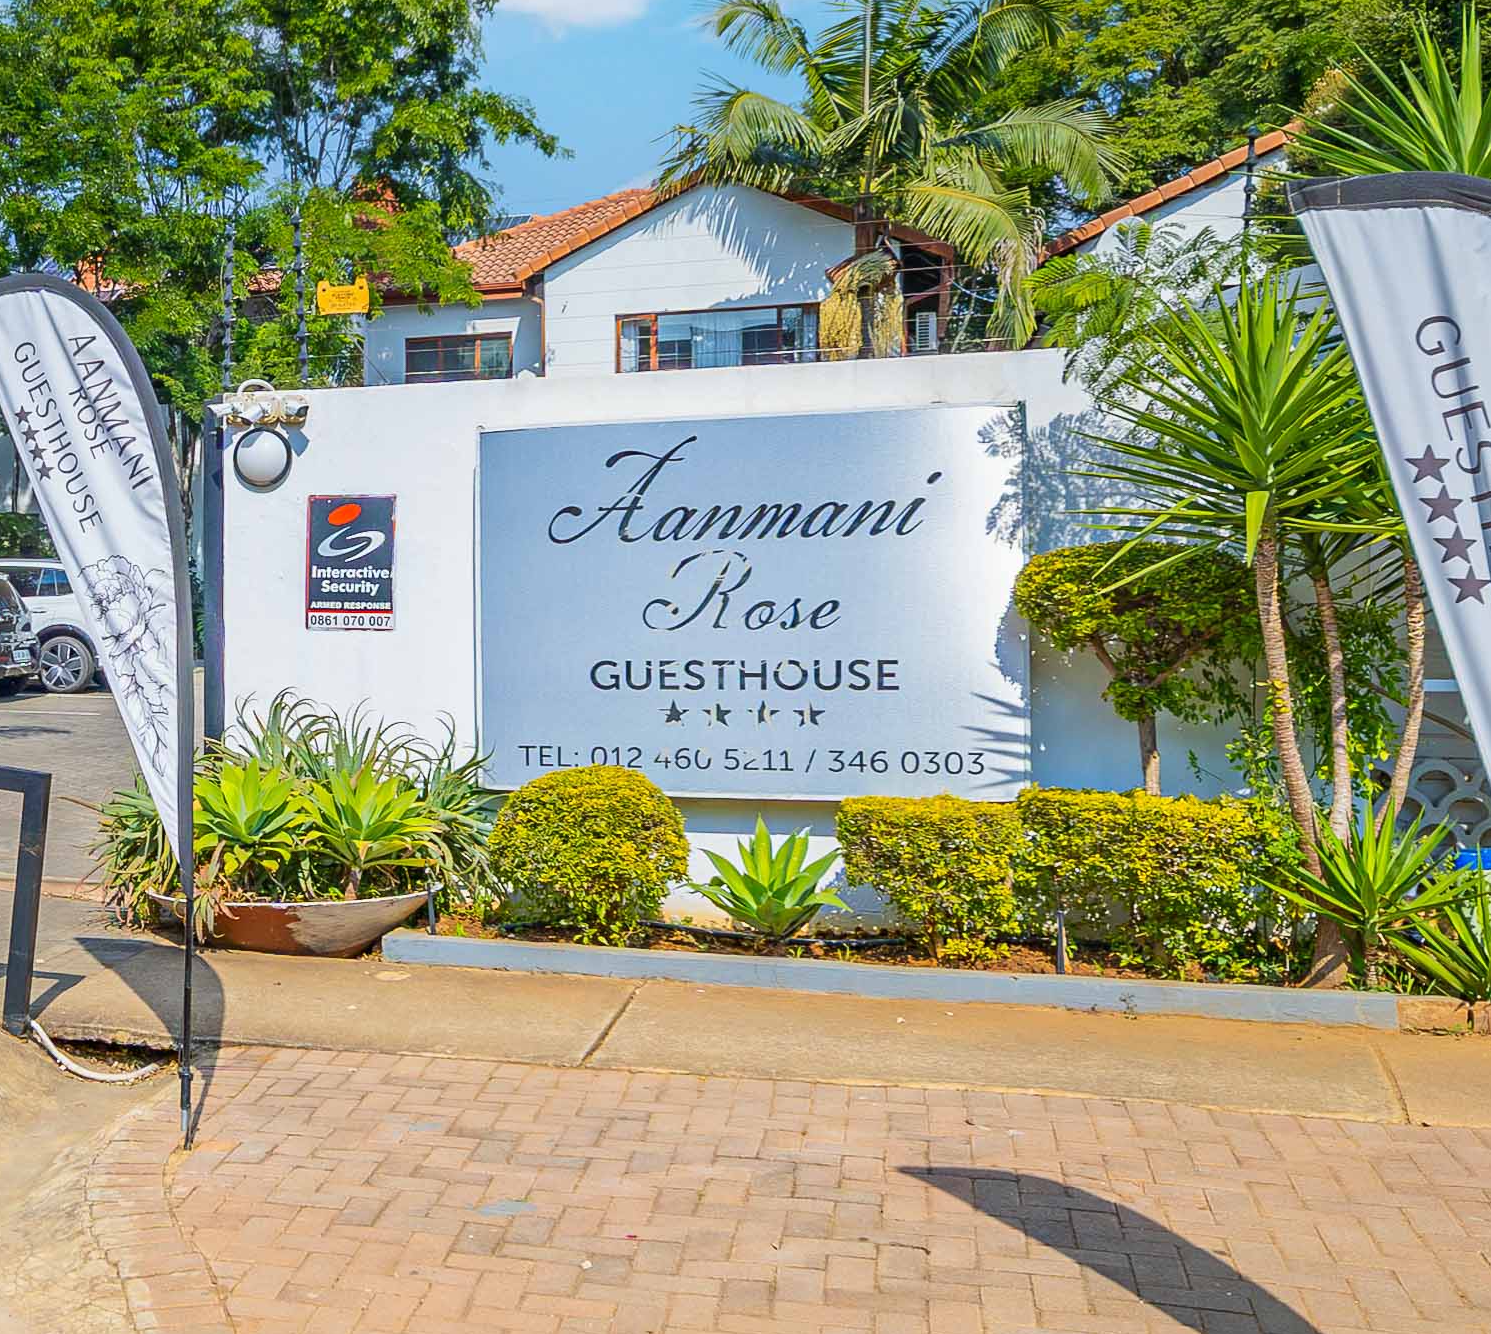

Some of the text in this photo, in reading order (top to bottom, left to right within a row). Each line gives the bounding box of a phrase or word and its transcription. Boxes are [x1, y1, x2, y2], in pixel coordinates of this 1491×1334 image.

[67, 335, 154, 490] AANMANI
[68, 385, 114, 460] ROSE
[14, 341, 104, 533] GUESTHOUSE
[547, 435, 943, 544] Aanmani
[311, 565, 390, 579] Interactive
[320, 579, 380, 597] Security
[310, 601, 392, 610] ARMED RESPONSE
[642, 548, 841, 632] Rose
[310, 614, 391, 626] 0861 070 007
[589, 658, 900, 691] GUESTHOUSE
[518, 744, 579, 768] TEL:
[590, 745, 644, 769] 012
[827, 749, 890, 774] 346
[900, 751, 985, 775] 0303
